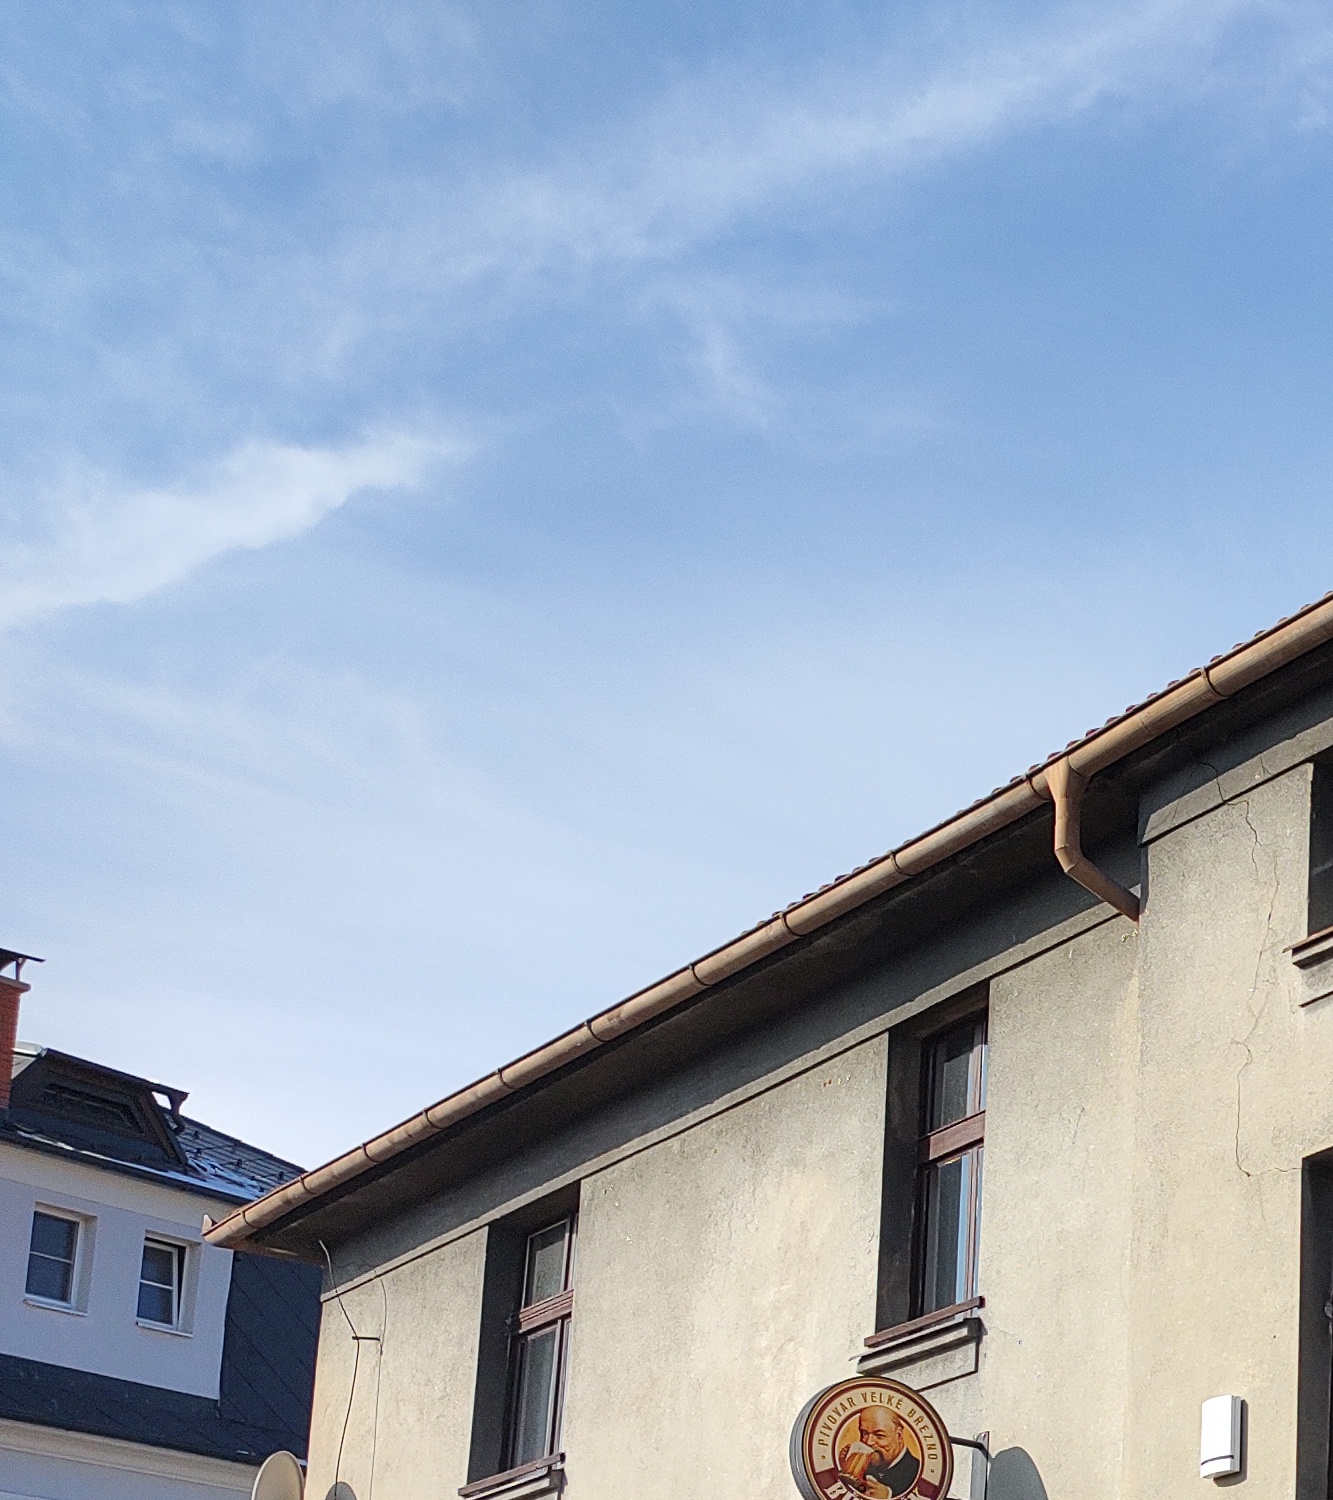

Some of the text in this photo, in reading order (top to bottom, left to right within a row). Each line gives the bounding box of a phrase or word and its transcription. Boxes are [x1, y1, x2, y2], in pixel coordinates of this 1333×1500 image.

[817, 1391, 938, 1460] PIVOVAR VELKÉ BŘEZNO
